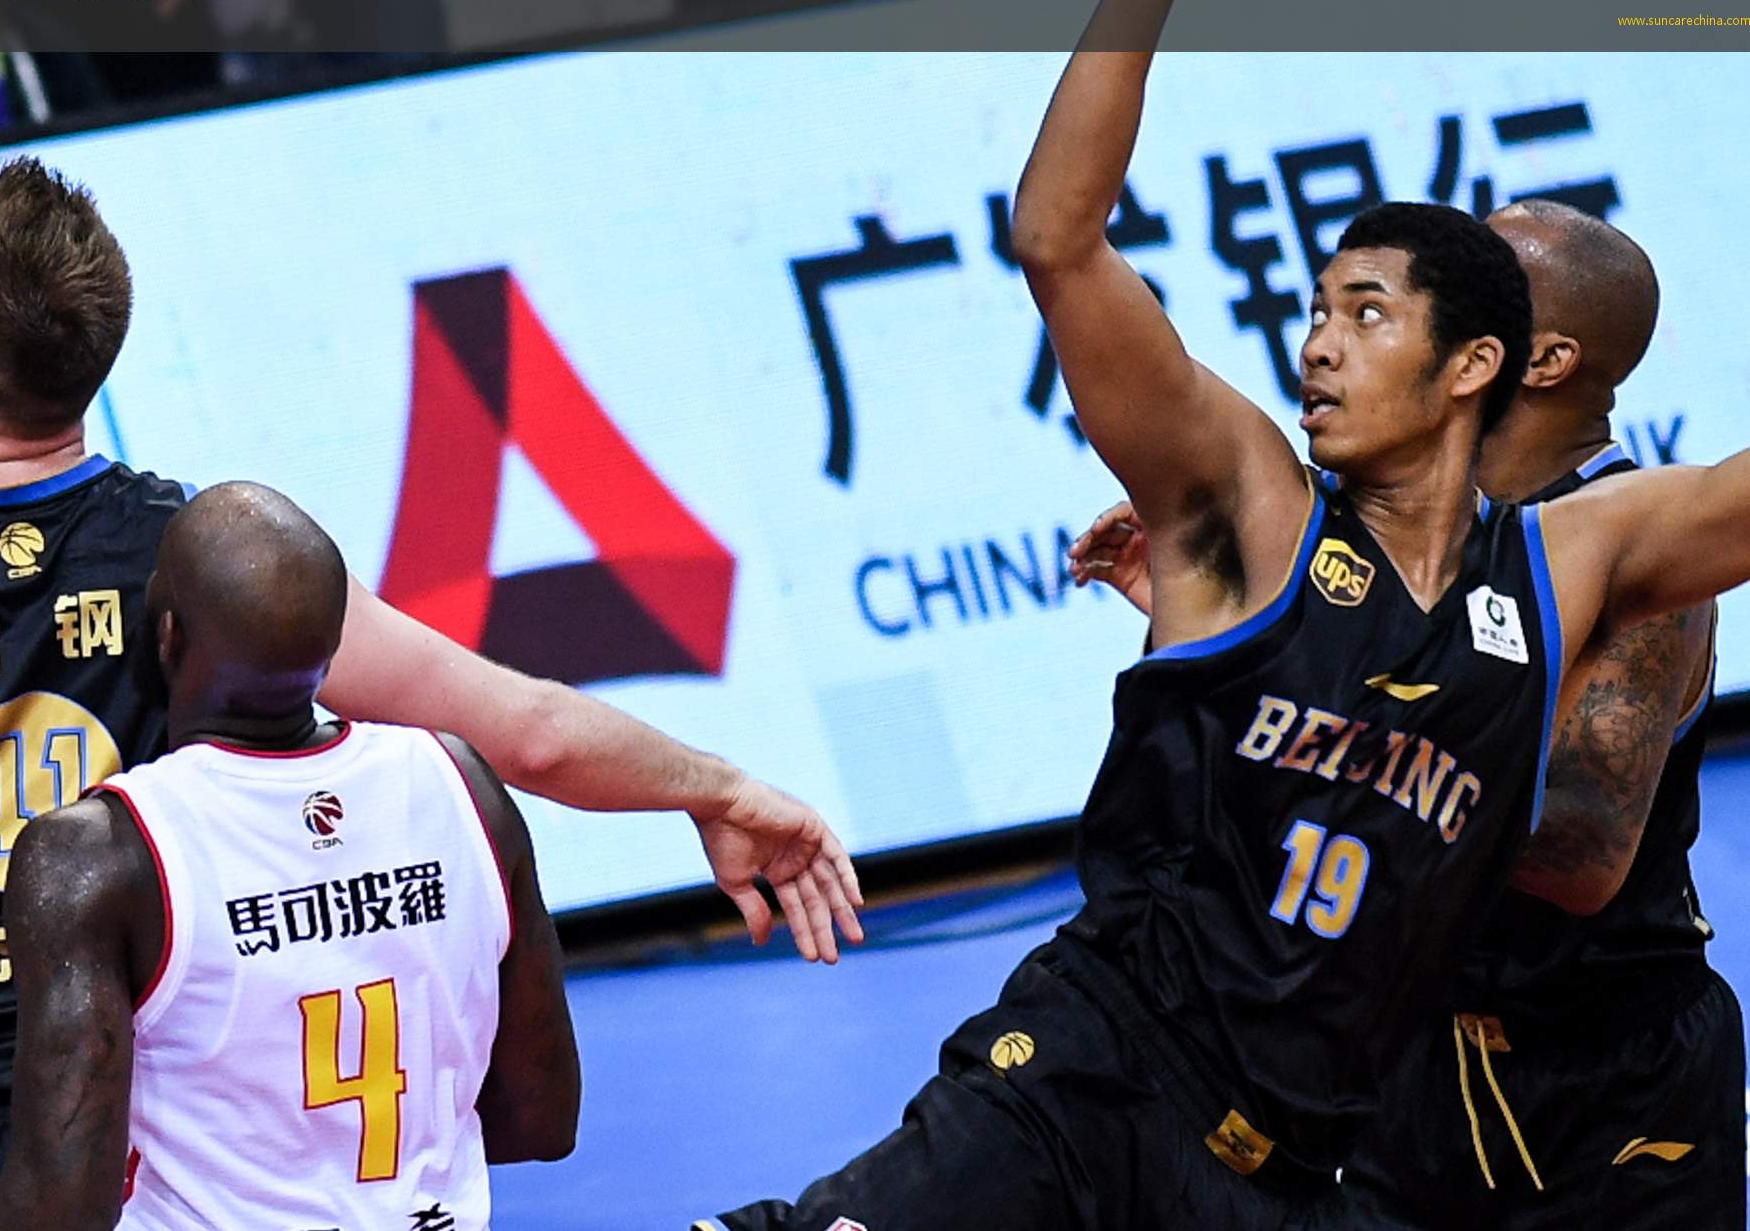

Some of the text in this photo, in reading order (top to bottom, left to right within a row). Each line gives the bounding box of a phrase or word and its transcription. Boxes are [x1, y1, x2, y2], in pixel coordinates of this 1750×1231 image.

[1316, 551, 1366, 598] ups
[312, 836, 344, 851] CBA
[1269, 818, 1371, 940] 19
[225, 860, 446, 957] 馬可波羅
[297, 976, 407, 1183] 4
